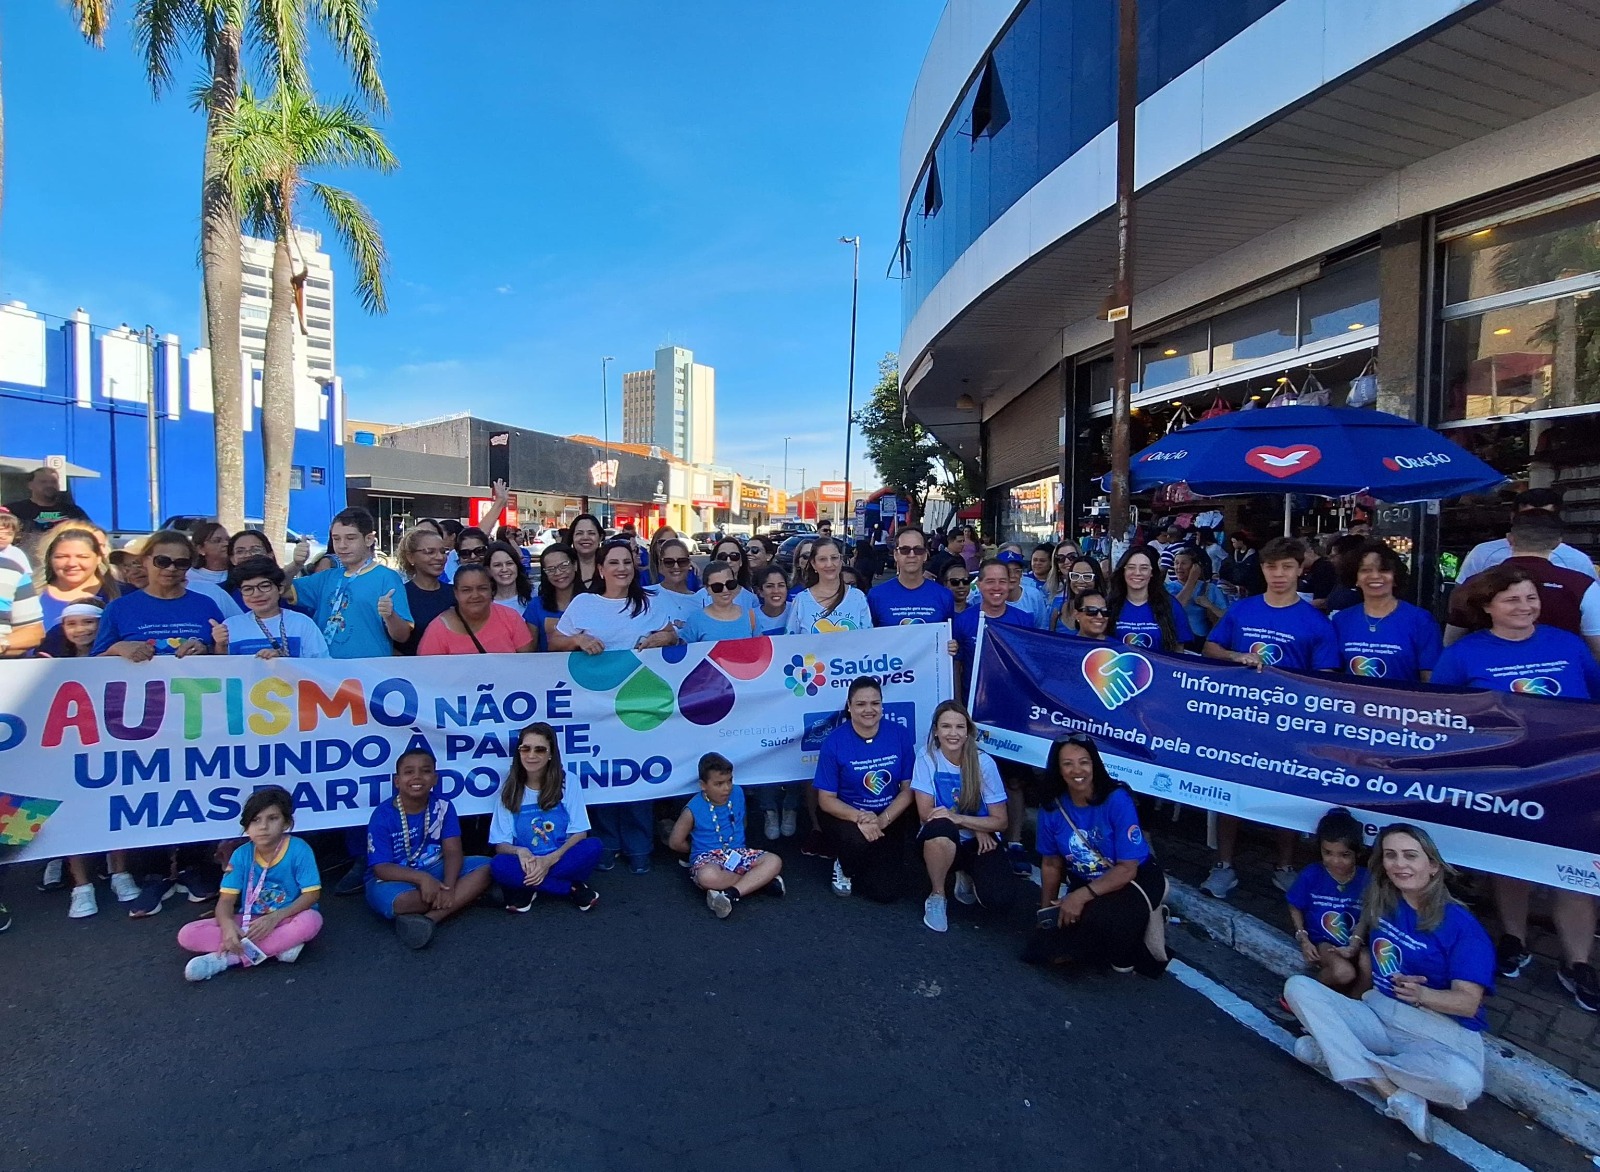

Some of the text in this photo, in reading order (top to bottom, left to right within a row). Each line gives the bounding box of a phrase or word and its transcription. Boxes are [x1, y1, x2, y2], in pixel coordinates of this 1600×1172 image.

[829, 653, 904, 676] Saúde
[830, 678, 852, 688] em
[41, 677, 418, 747] AUTISMO
[434, 683, 537, 729] NÃO
[546, 681, 573, 719] É
[1172, 671, 1475, 734] “Informação gera empatia,
[718, 723, 795, 737] Secretaria da
[1186, 699, 1448, 752] empatia gera respeito”
[760, 736, 794, 747] Saúde
[74, 723, 601, 789] UM MUNDO À PAE,
[1028, 706, 1545, 821] 3ª Caminhada pela conscientização do AUTISMO
[1134, 768, 1143, 776] da
[109, 787, 242, 831] MAS
[431, 766, 500, 800] DO
[1178, 779, 1231, 802] Marília
[1556, 864, 1597, 880] VÂNIA
